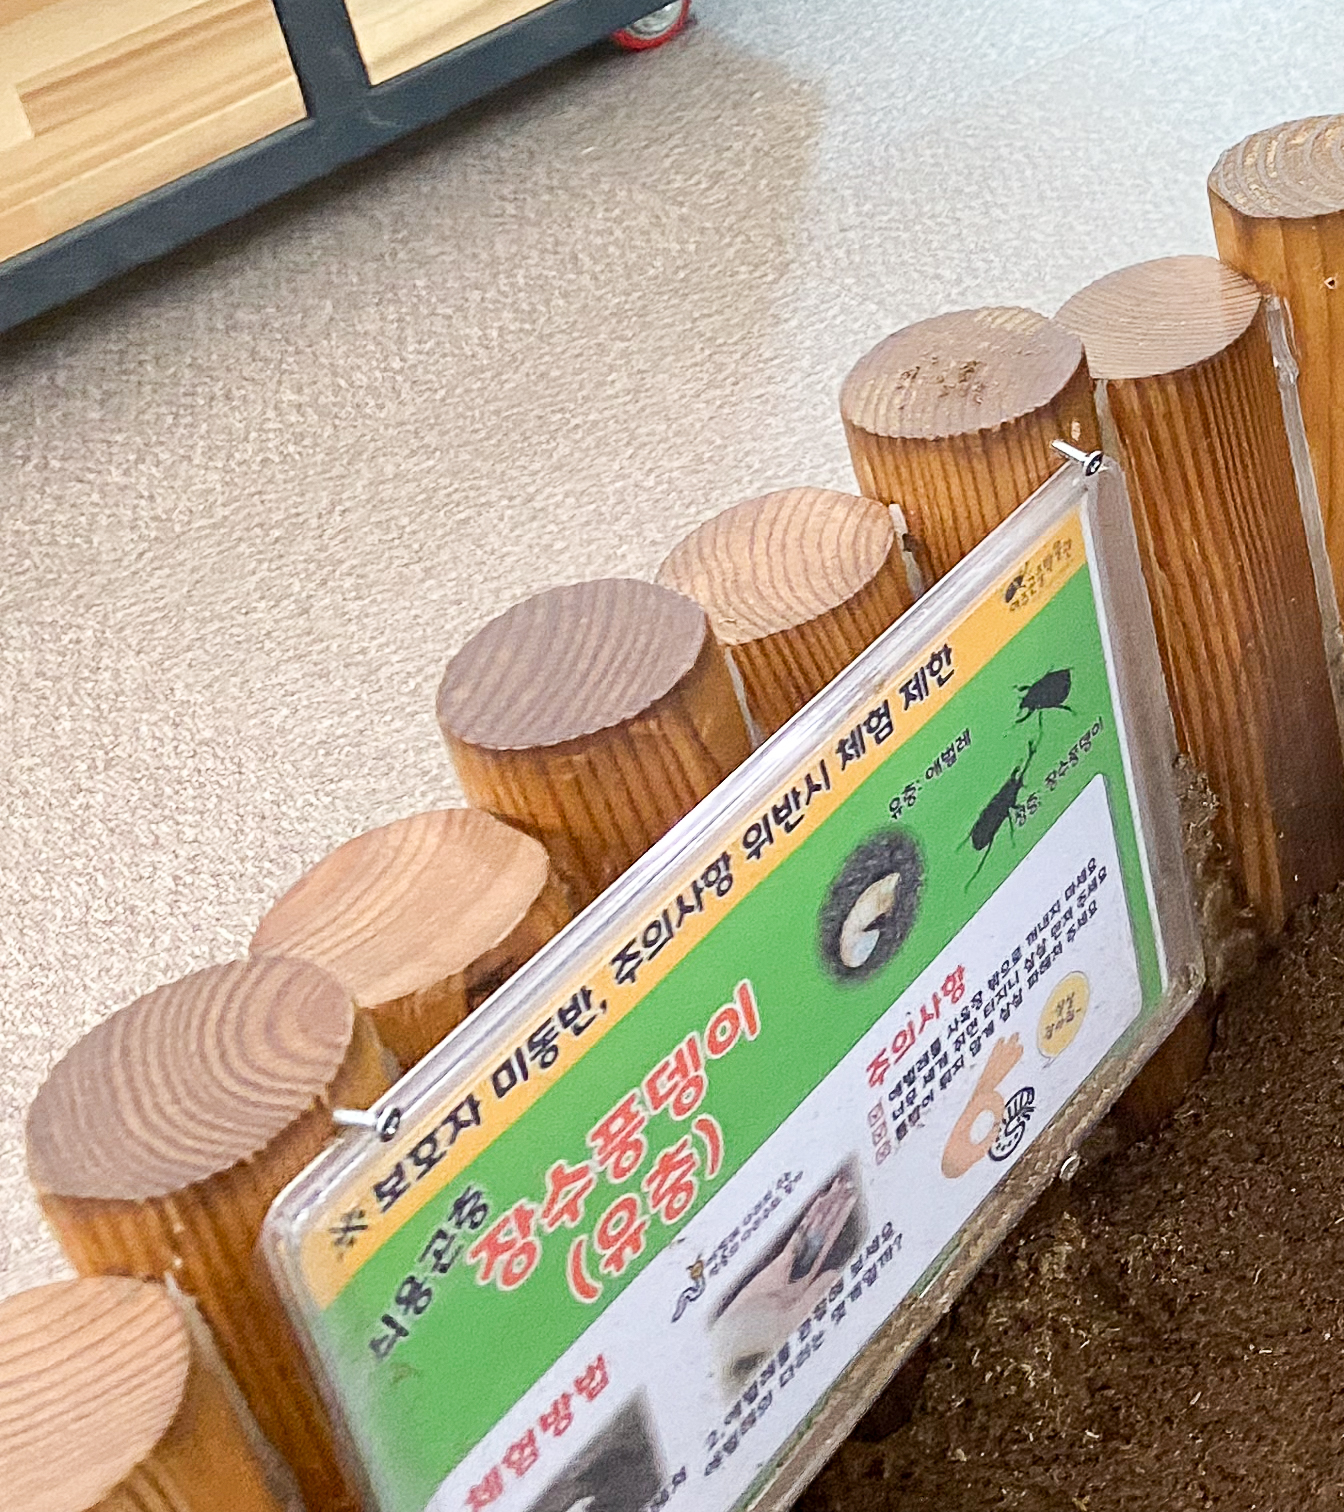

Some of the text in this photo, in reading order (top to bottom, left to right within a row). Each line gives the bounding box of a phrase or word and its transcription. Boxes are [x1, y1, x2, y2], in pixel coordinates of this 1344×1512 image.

[889, 728, 971, 819] 유충: 애벌레
[1045, 716, 1103, 791] 장수풍뎅이
[373, 1093, 480, 1213] 보호자
[491, 986, 607, 1098] 미동반,
[609, 851, 733, 984] 주의사항
[743, 759, 830, 860] 위반시
[835, 699, 893, 771] 체험
[899, 644, 954, 710] 제한
[889, 1037, 941, 1101] 애벌레를
[947, 991, 983, 1039] 사육장
[1065, 858, 1096, 901] 마세요
[892, 1087, 917, 1121] 너무
[983, 970, 1019, 1019] 터지니
[1077, 866, 1107, 908] 주세요
[1067, 900, 1097, 942] 주세요
[867, 966, 965, 1087] 주의사항
[467, 983, 758, 1288] 장수풍뎅이
[569, 1118, 721, 1300] (유충)
[369, 1186, 488, 1358] 식용곤충
[467, 1355, 608, 1512] 체험방법
